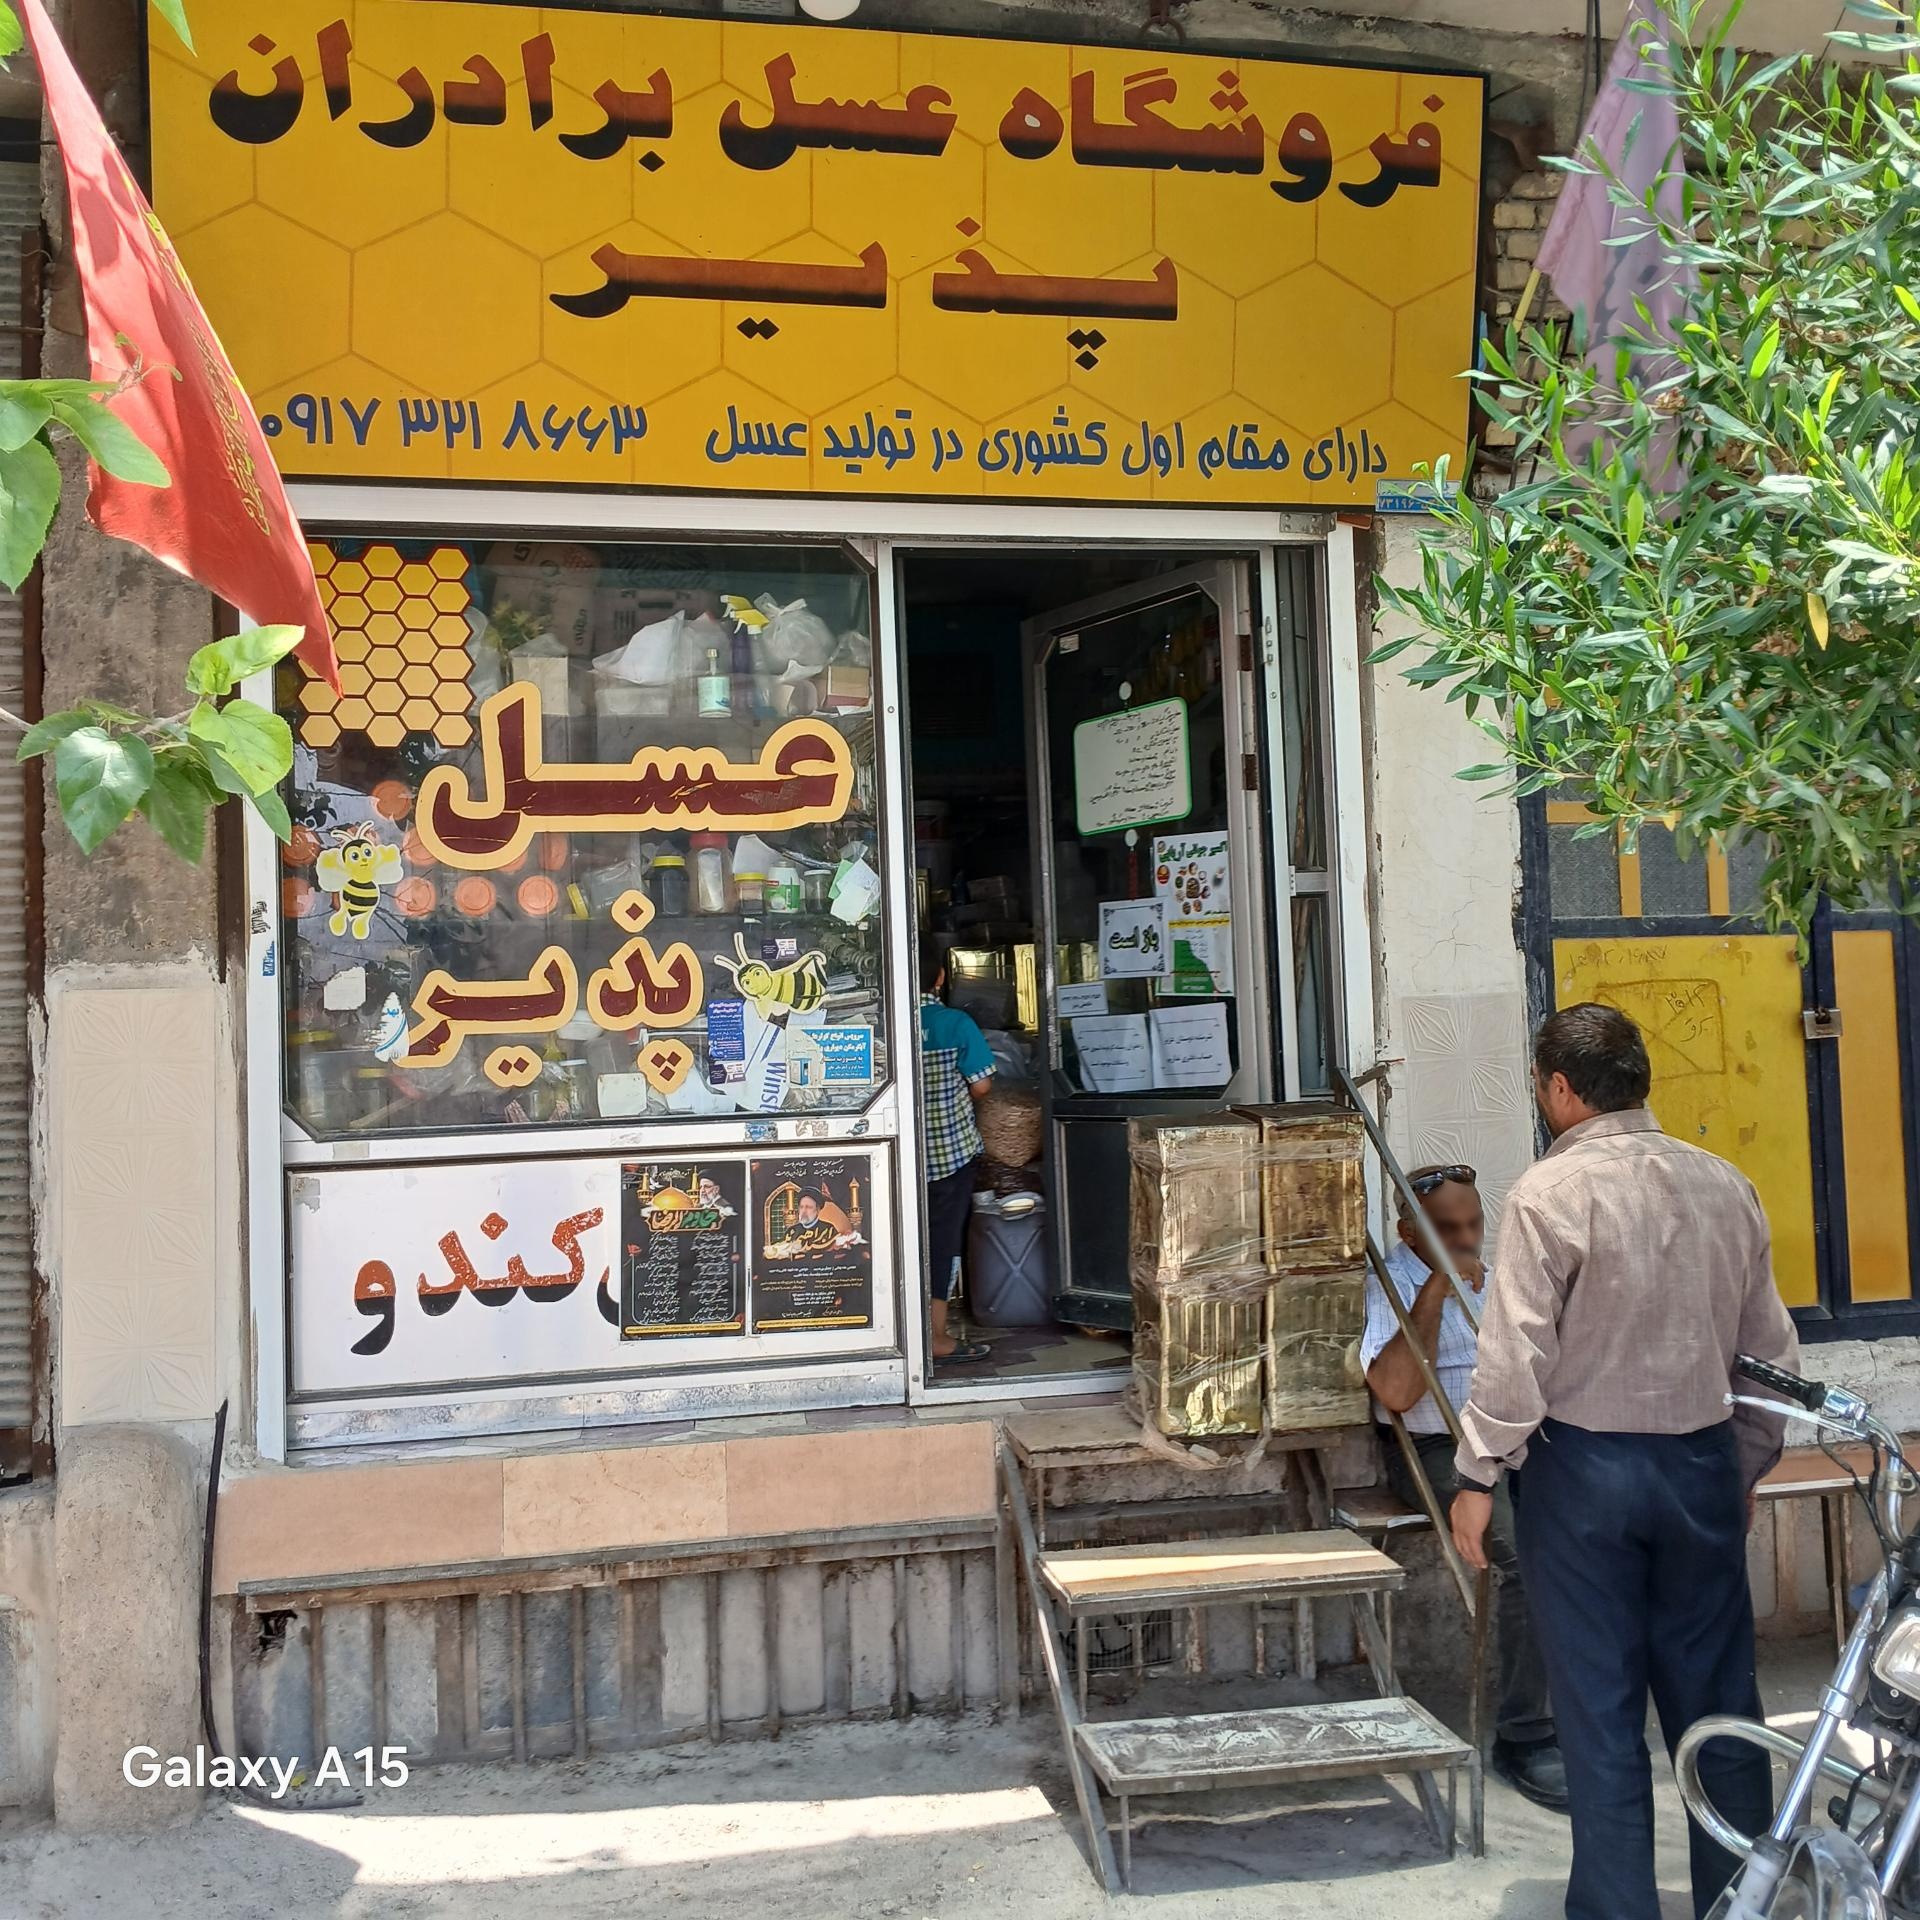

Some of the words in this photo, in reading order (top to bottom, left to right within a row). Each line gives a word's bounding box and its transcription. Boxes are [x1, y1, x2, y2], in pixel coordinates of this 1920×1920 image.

[208, 18, 673, 173] برادران
[718, 52, 959, 172] عسل
[997, 67, 1445, 208] فروشگاه
[549, 215, 1179, 371] پذیر
[261, 393, 381, 446] ۰۹۱۷
[399, 398, 481, 450] ۳۲۱
[502, 400, 648, 455] ۸۶۶۳
[705, 405, 807, 464] عسل
[823, 409, 916, 474] تولید
[932, 426, 964, 472] در
[978, 405, 1106, 475] کشوری
[1121, 420, 1184, 477] اول
[1198, 424, 1289, 479] مقام
[1303, 427, 1388, 482] دارای
[417, 682, 853, 870] عسل
[1108, 926, 1139, 950] است
[1141, 924, 1160, 953] باز
[396, 890, 702, 1092] پذیر
[759, 1062, 787, 1112] Winst
[350, 1206, 604, 1357] کندو
